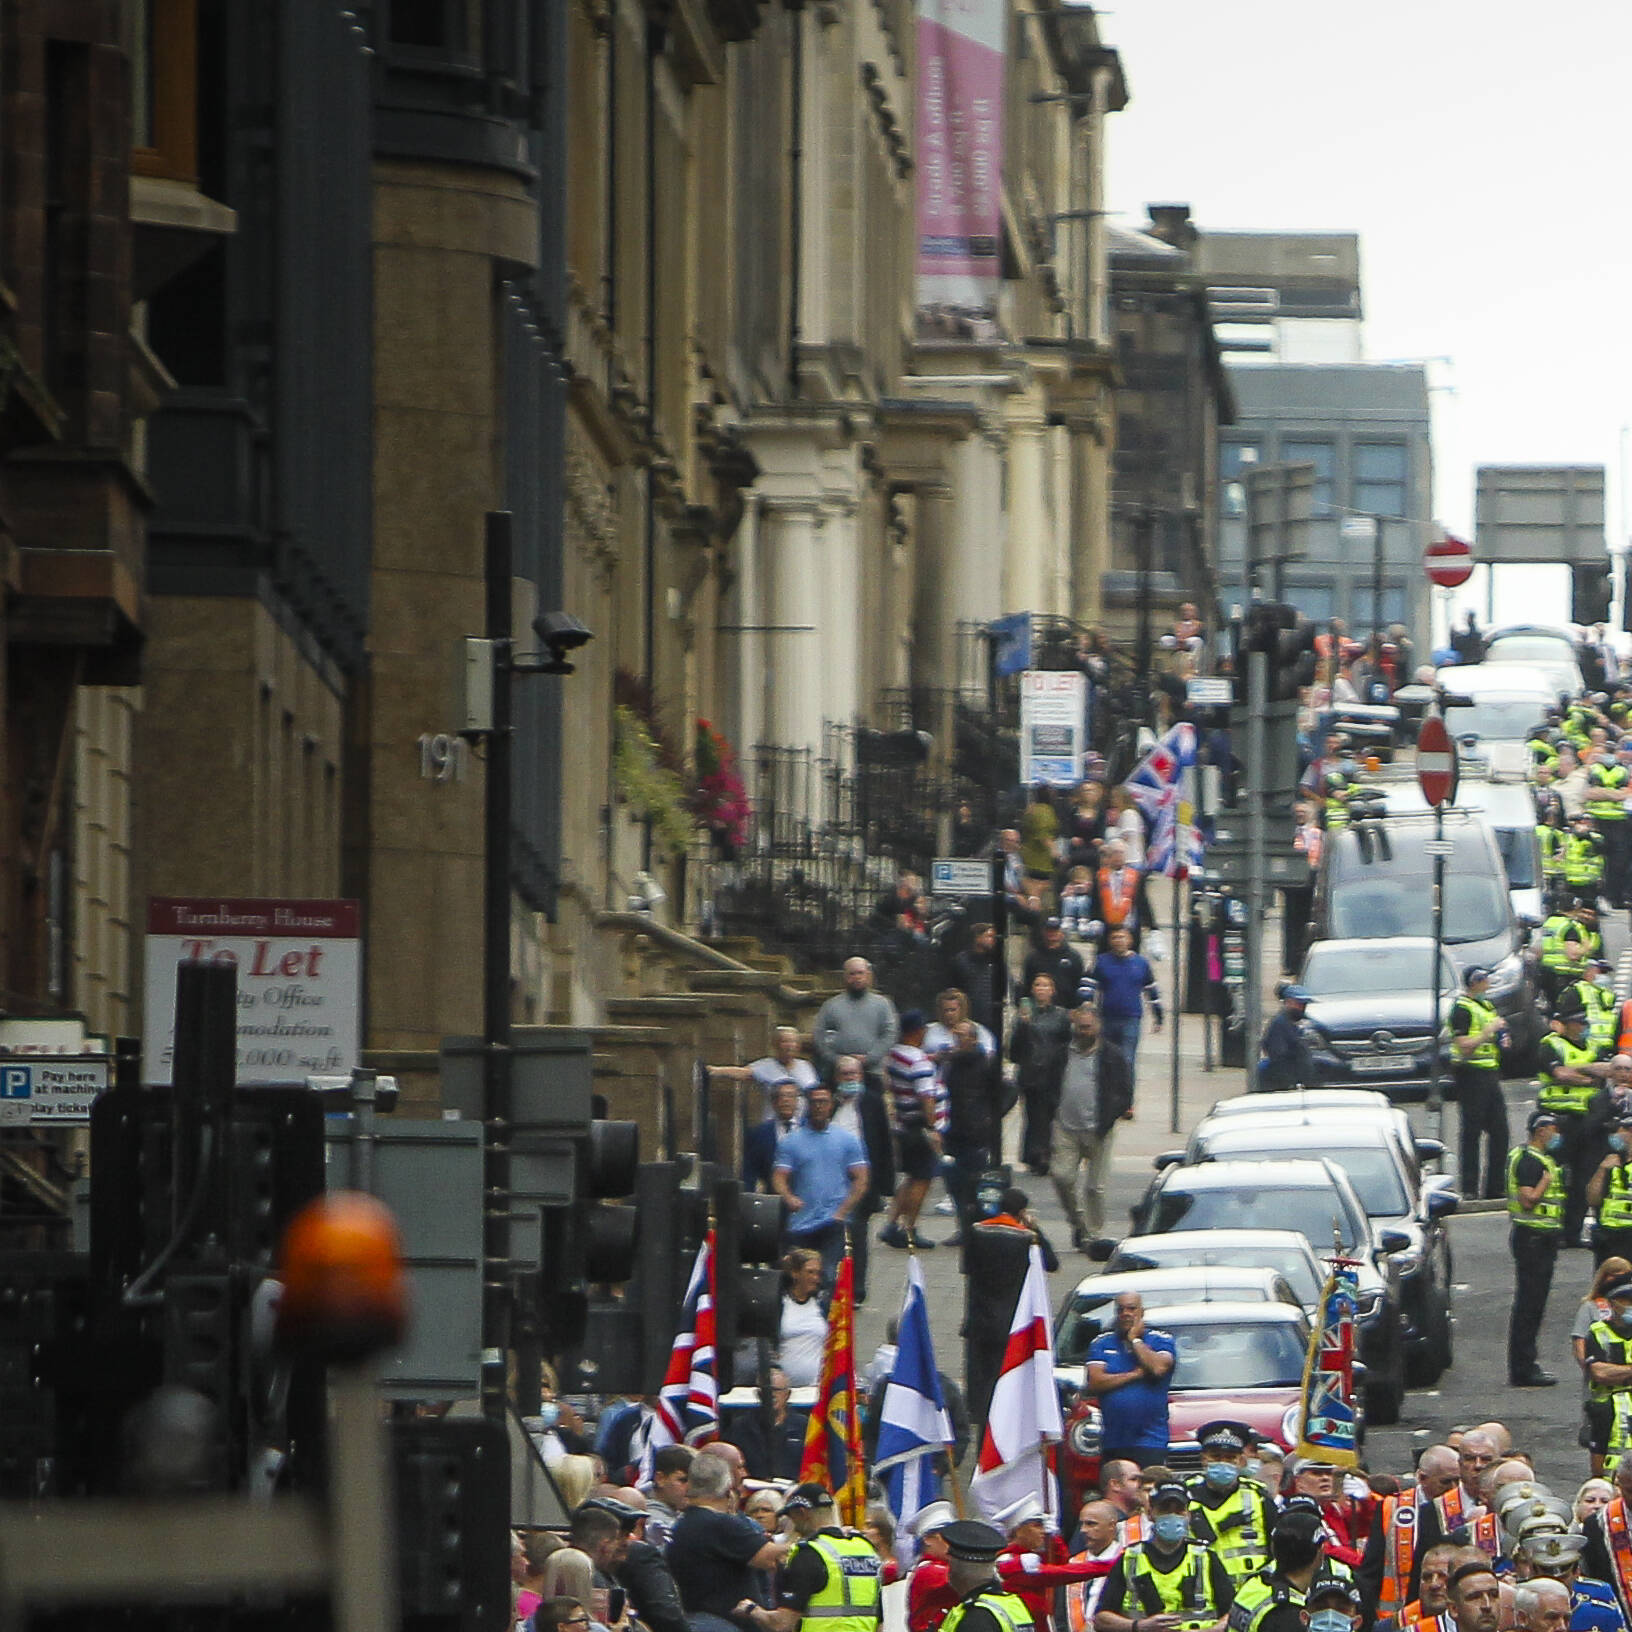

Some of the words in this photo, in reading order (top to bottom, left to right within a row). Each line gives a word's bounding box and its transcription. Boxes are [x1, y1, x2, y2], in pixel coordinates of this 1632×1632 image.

[172, 906, 269, 928] Turnberry
[274, 907, 334, 927] House
[247, 940, 324, 977] Let
[262, 984, 324, 1009] Office
[5, 1070, 26, 1096] P
[42, 1070, 65, 1083] Pay
[68, 1071, 97, 1081] here
[34, 1085, 48, 1094] at
[1316, 1579, 1345, 1589] POLICE
